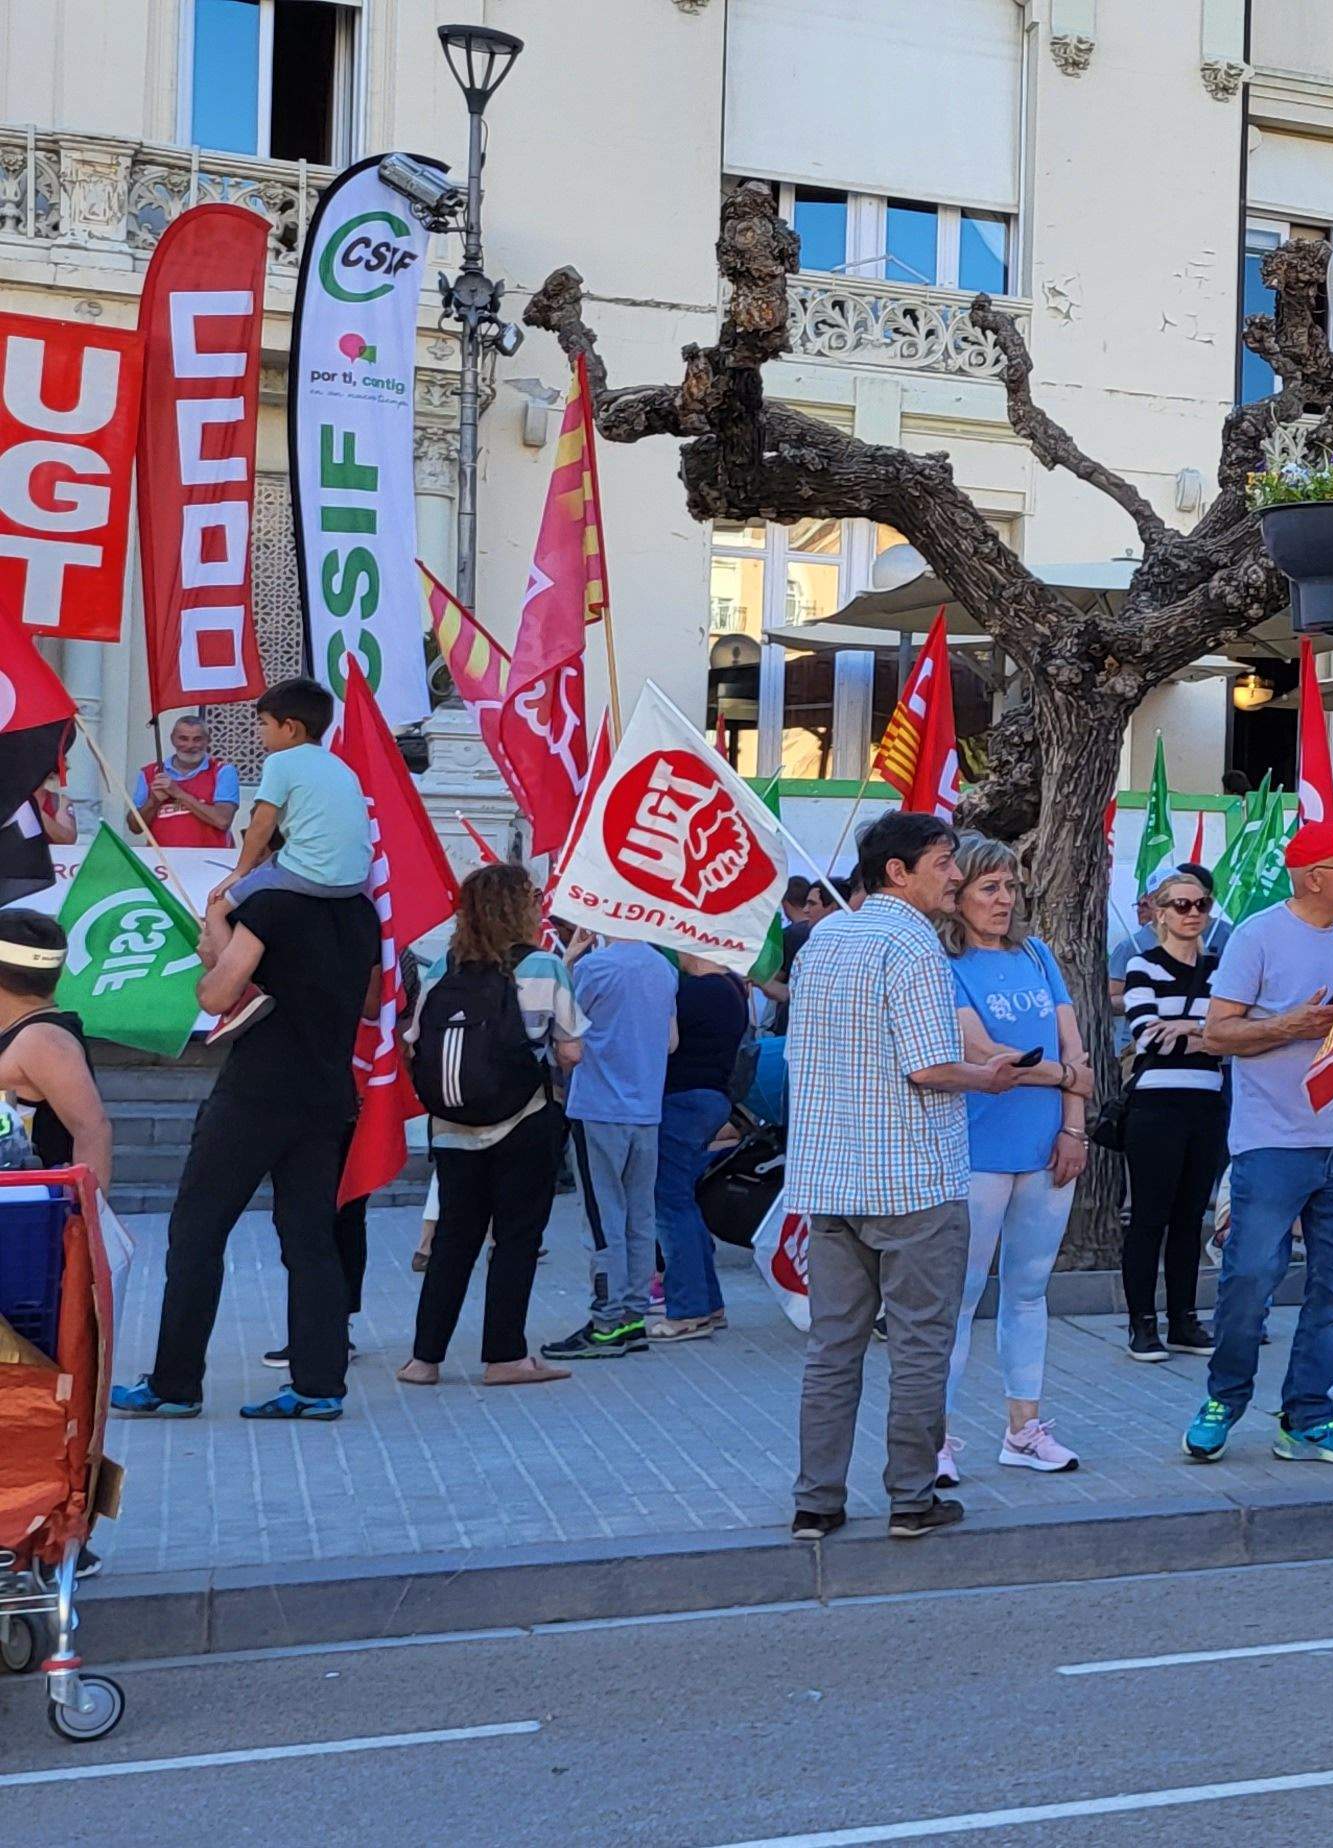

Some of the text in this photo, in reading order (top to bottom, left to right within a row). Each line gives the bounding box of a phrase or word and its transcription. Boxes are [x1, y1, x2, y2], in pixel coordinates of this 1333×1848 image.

[341, 236, 418, 277] CSIF
[310, 370, 338, 383] por
[0, 335, 120, 627] UGT
[169, 290, 254, 692] CCOO
[617, 758, 712, 880] UGT
[568, 884, 747, 952] www.UGT.es
